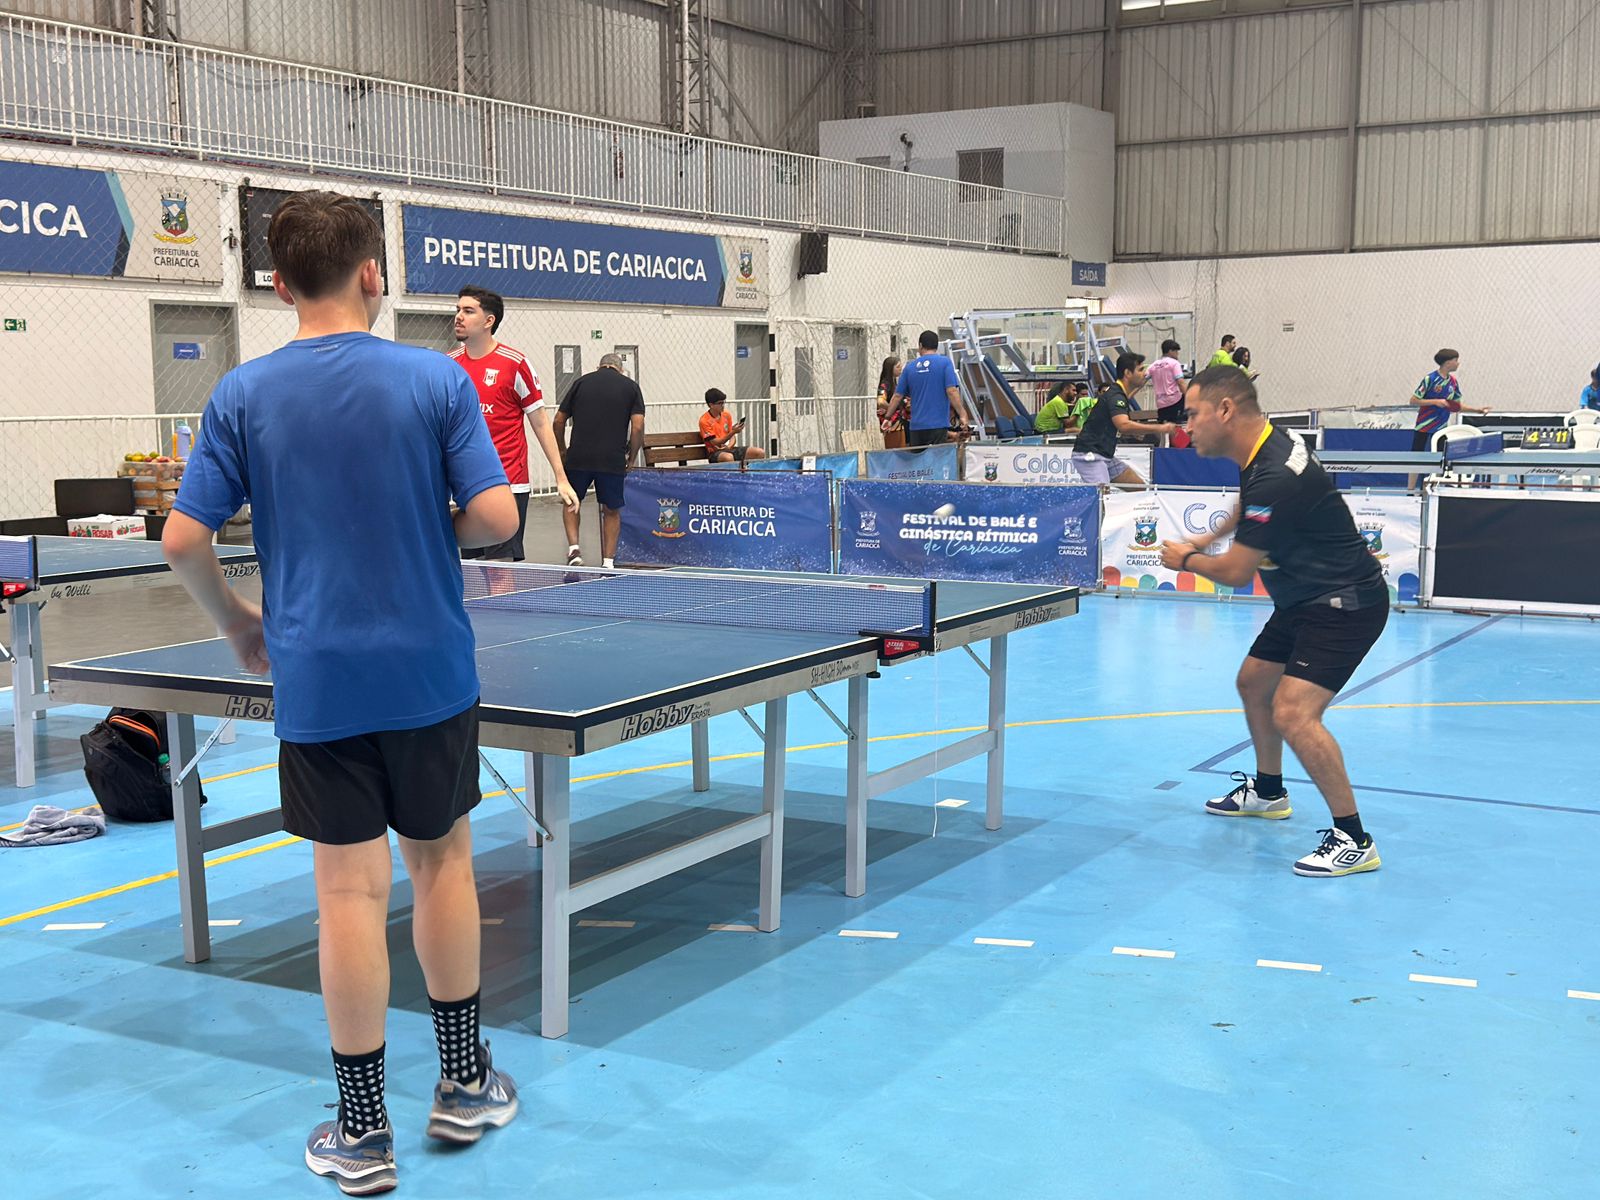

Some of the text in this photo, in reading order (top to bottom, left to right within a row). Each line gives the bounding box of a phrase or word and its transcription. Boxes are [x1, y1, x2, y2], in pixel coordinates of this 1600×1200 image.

[153, 247, 190, 256] PREFEITURA
[424, 236, 707, 282] PREFEITURA DE CARIACICA
[154, 256, 200, 268] CARIACICA
[1079, 267, 1099, 282] SAÍDA
[1527, 431, 1539, 443] 4
[1556, 431, 1568, 443] 11
[689, 504, 776, 519] PREFEITURA DE
[688, 518, 776, 537] CARIACICA
[903, 513, 1038, 528] FESTIVAL DE BALÉ E
[899, 526, 1039, 544] GINÁSTICA RÍTMICA
[923, 538, 1023, 557] de Cariacica
[50, 584, 92, 599] by Willi
[1014, 606, 1052, 629] Hobby
[620, 704, 695, 741] Hobby
